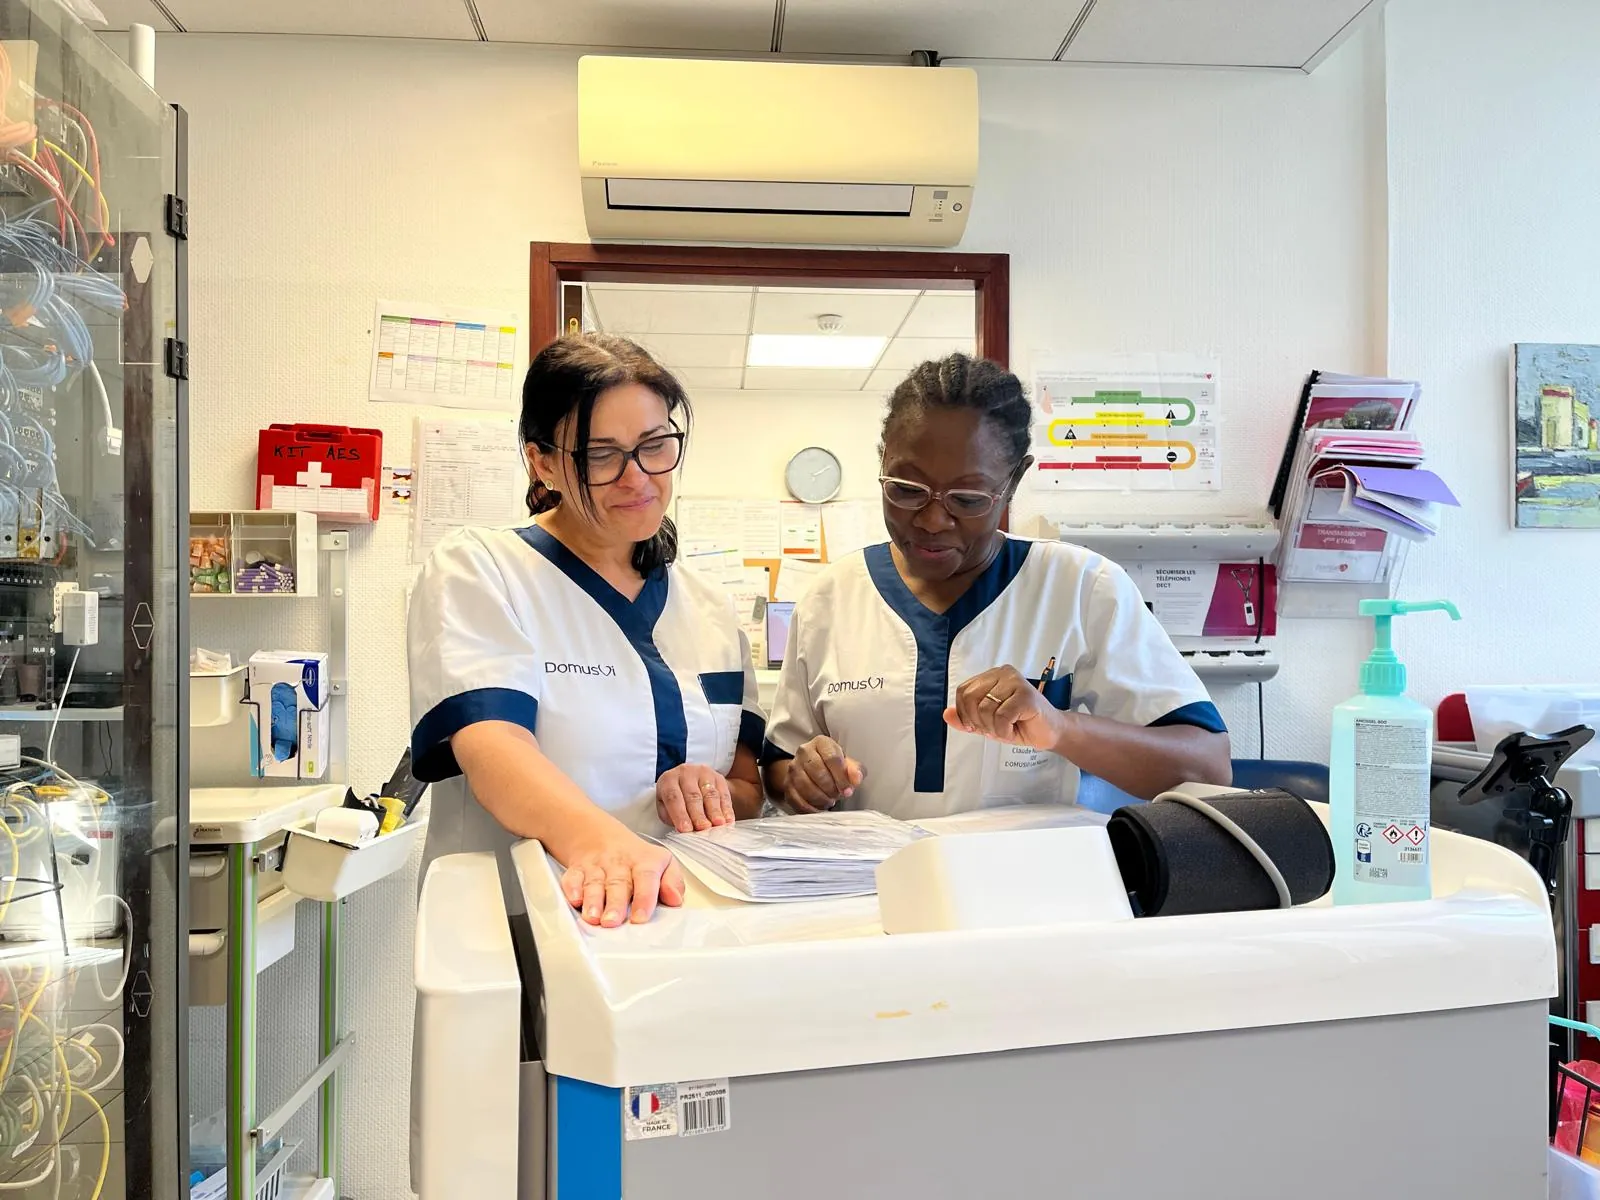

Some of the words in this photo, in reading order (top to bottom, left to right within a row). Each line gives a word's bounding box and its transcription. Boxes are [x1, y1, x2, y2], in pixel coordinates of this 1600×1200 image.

[273, 445, 312, 458] KIT
[326, 446, 361, 460] AES
[642, 1124, 671, 1132] FRANCE
